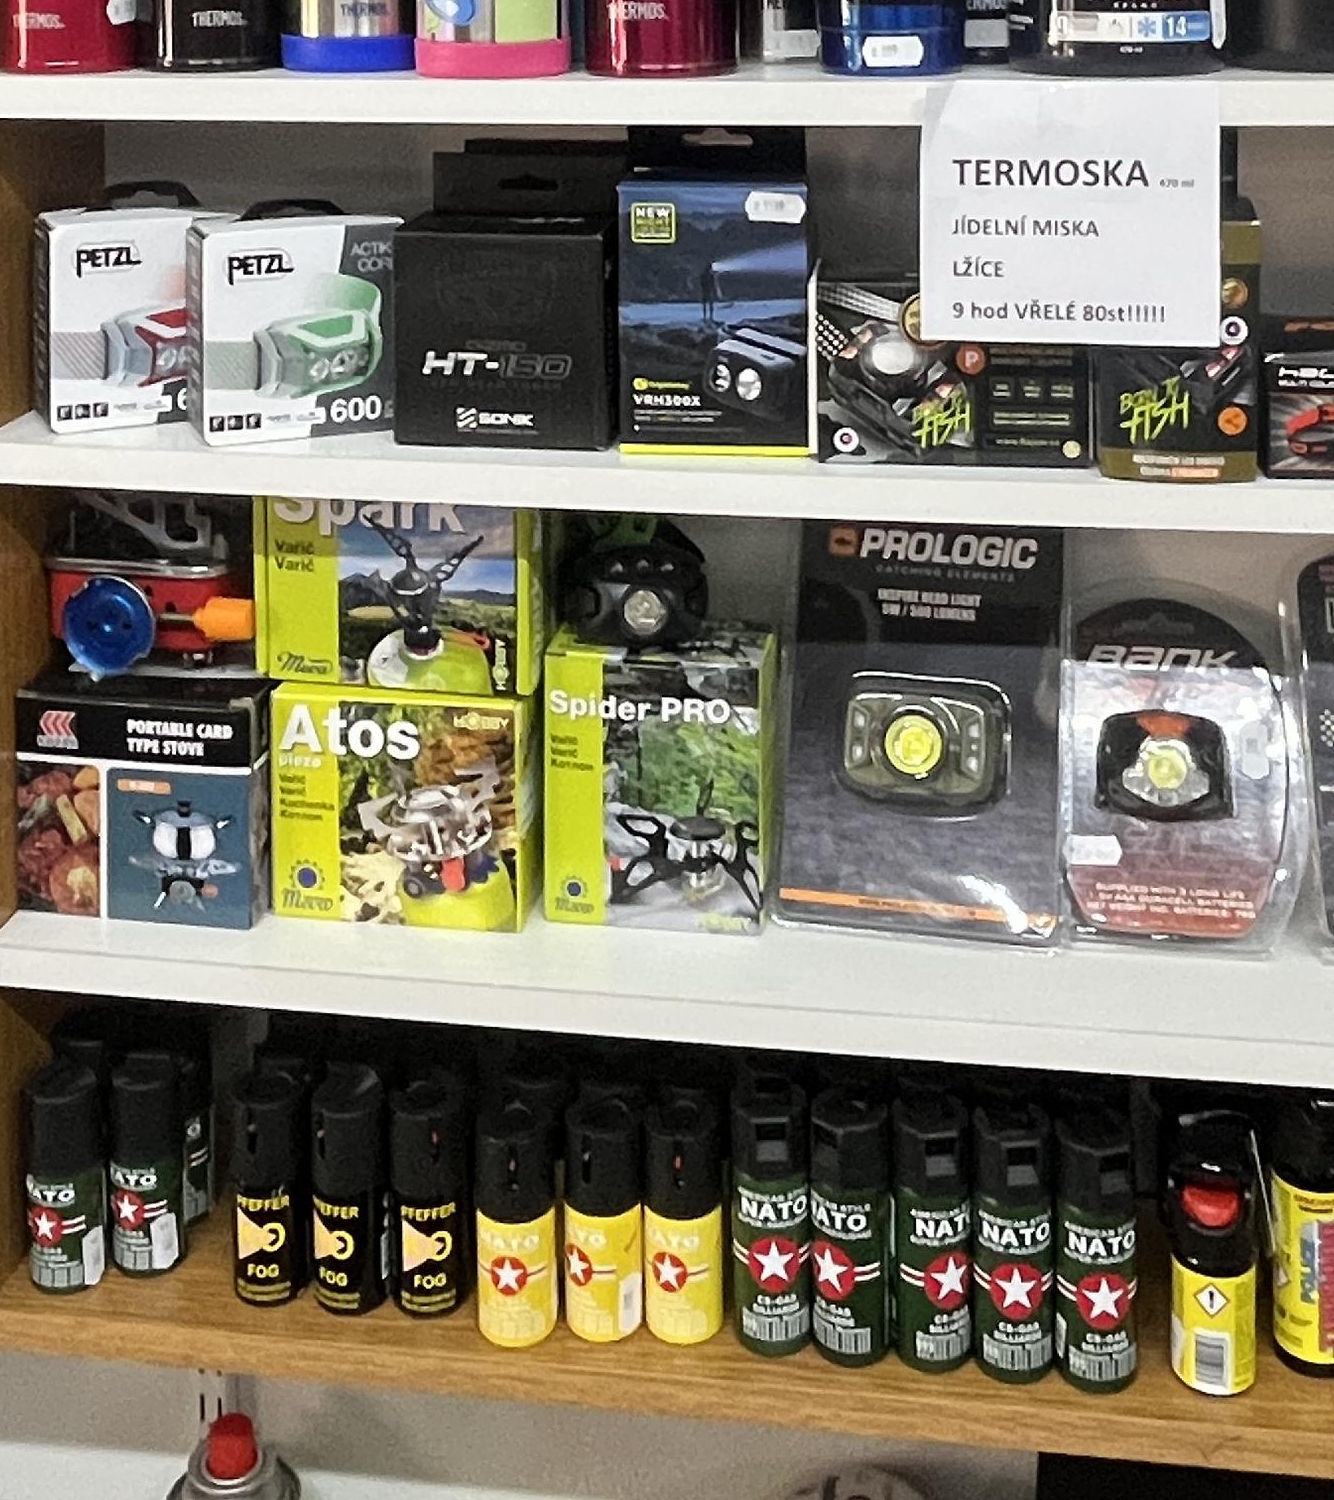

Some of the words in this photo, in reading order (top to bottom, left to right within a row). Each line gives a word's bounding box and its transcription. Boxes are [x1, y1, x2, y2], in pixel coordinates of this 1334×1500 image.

[191, 10, 249, 28] THERMOS
[1165, 15, 1189, 38] 14
[951, 157, 1150, 189] TERMOSKA
[634, 205, 671, 219] NEW
[951, 213, 1027, 238] JÍDELNÍ
[1032, 218, 1100, 238] MISKA
[75, 245, 142, 279] PETZL
[227, 252, 295, 287] PETZL
[951, 254, 1006, 279] LŽÍCE
[951, 301, 965, 320] 9
[970, 301, 1009, 321] hod
[1014, 296, 1077, 322] VŘELÉ
[329, 395, 381, 424] 600
[859, 527, 1040, 570] PROLOGIC
[548, 690, 652, 723] Spider
[660, 696, 732, 726] PRO
[126, 718, 195, 740] PORTABLE
[277, 704, 421, 762] Atos
[126, 737, 161, 756] TYPE
[740, 1194, 809, 1225] NATO
[915, 1211, 969, 1239] NAT
[981, 1220, 1051, 1247] NATO
[1068, 1228, 1137, 1258] NATO
[246, 1262, 281, 1279] FOG
[318, 1266, 349, 1288] FOG
[413, 1272, 448, 1290] FOG
